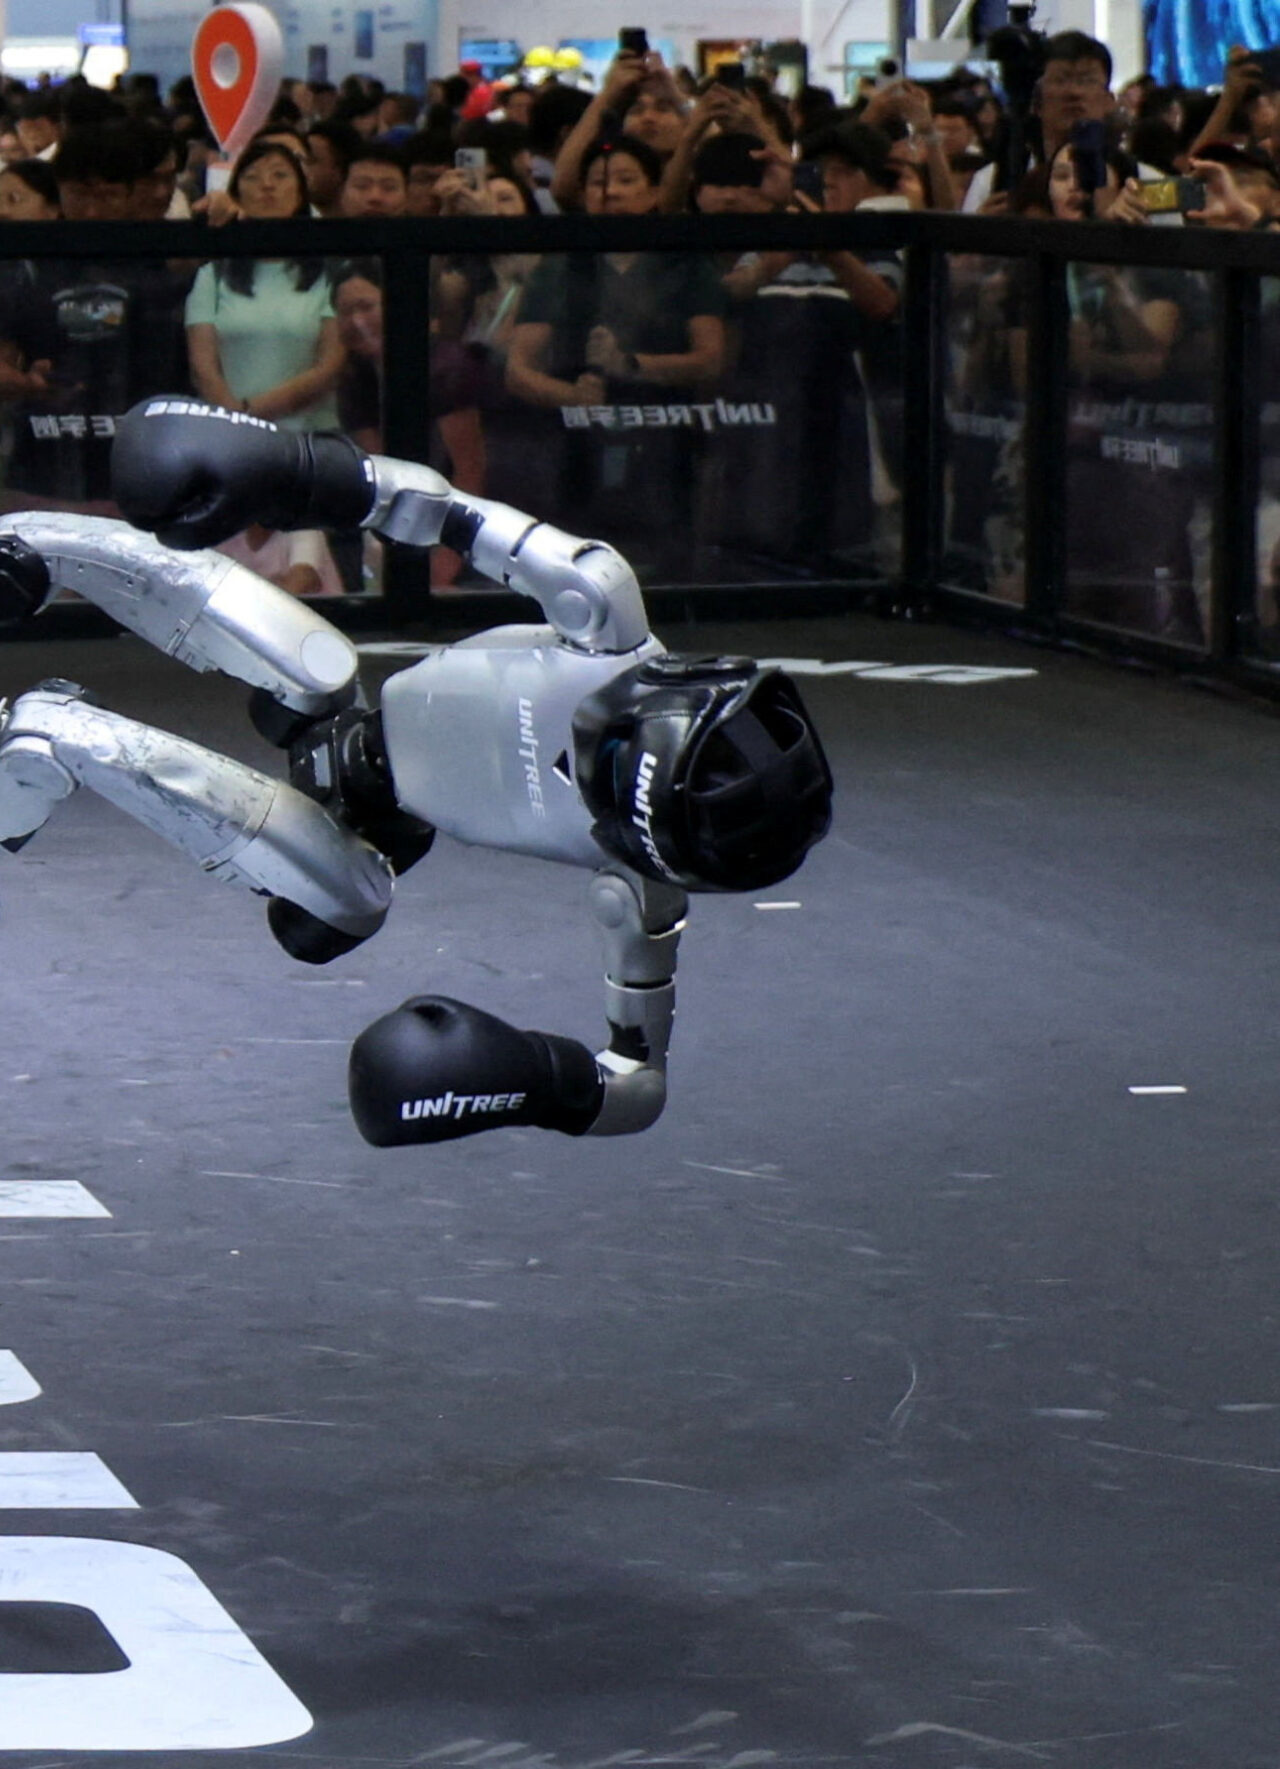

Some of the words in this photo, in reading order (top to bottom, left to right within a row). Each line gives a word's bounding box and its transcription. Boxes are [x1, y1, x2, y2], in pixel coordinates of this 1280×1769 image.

[145, 401, 278, 433] UNITREE
[518, 697, 546, 817] UNITREE
[401, 1091, 527, 1120] UNITREE
